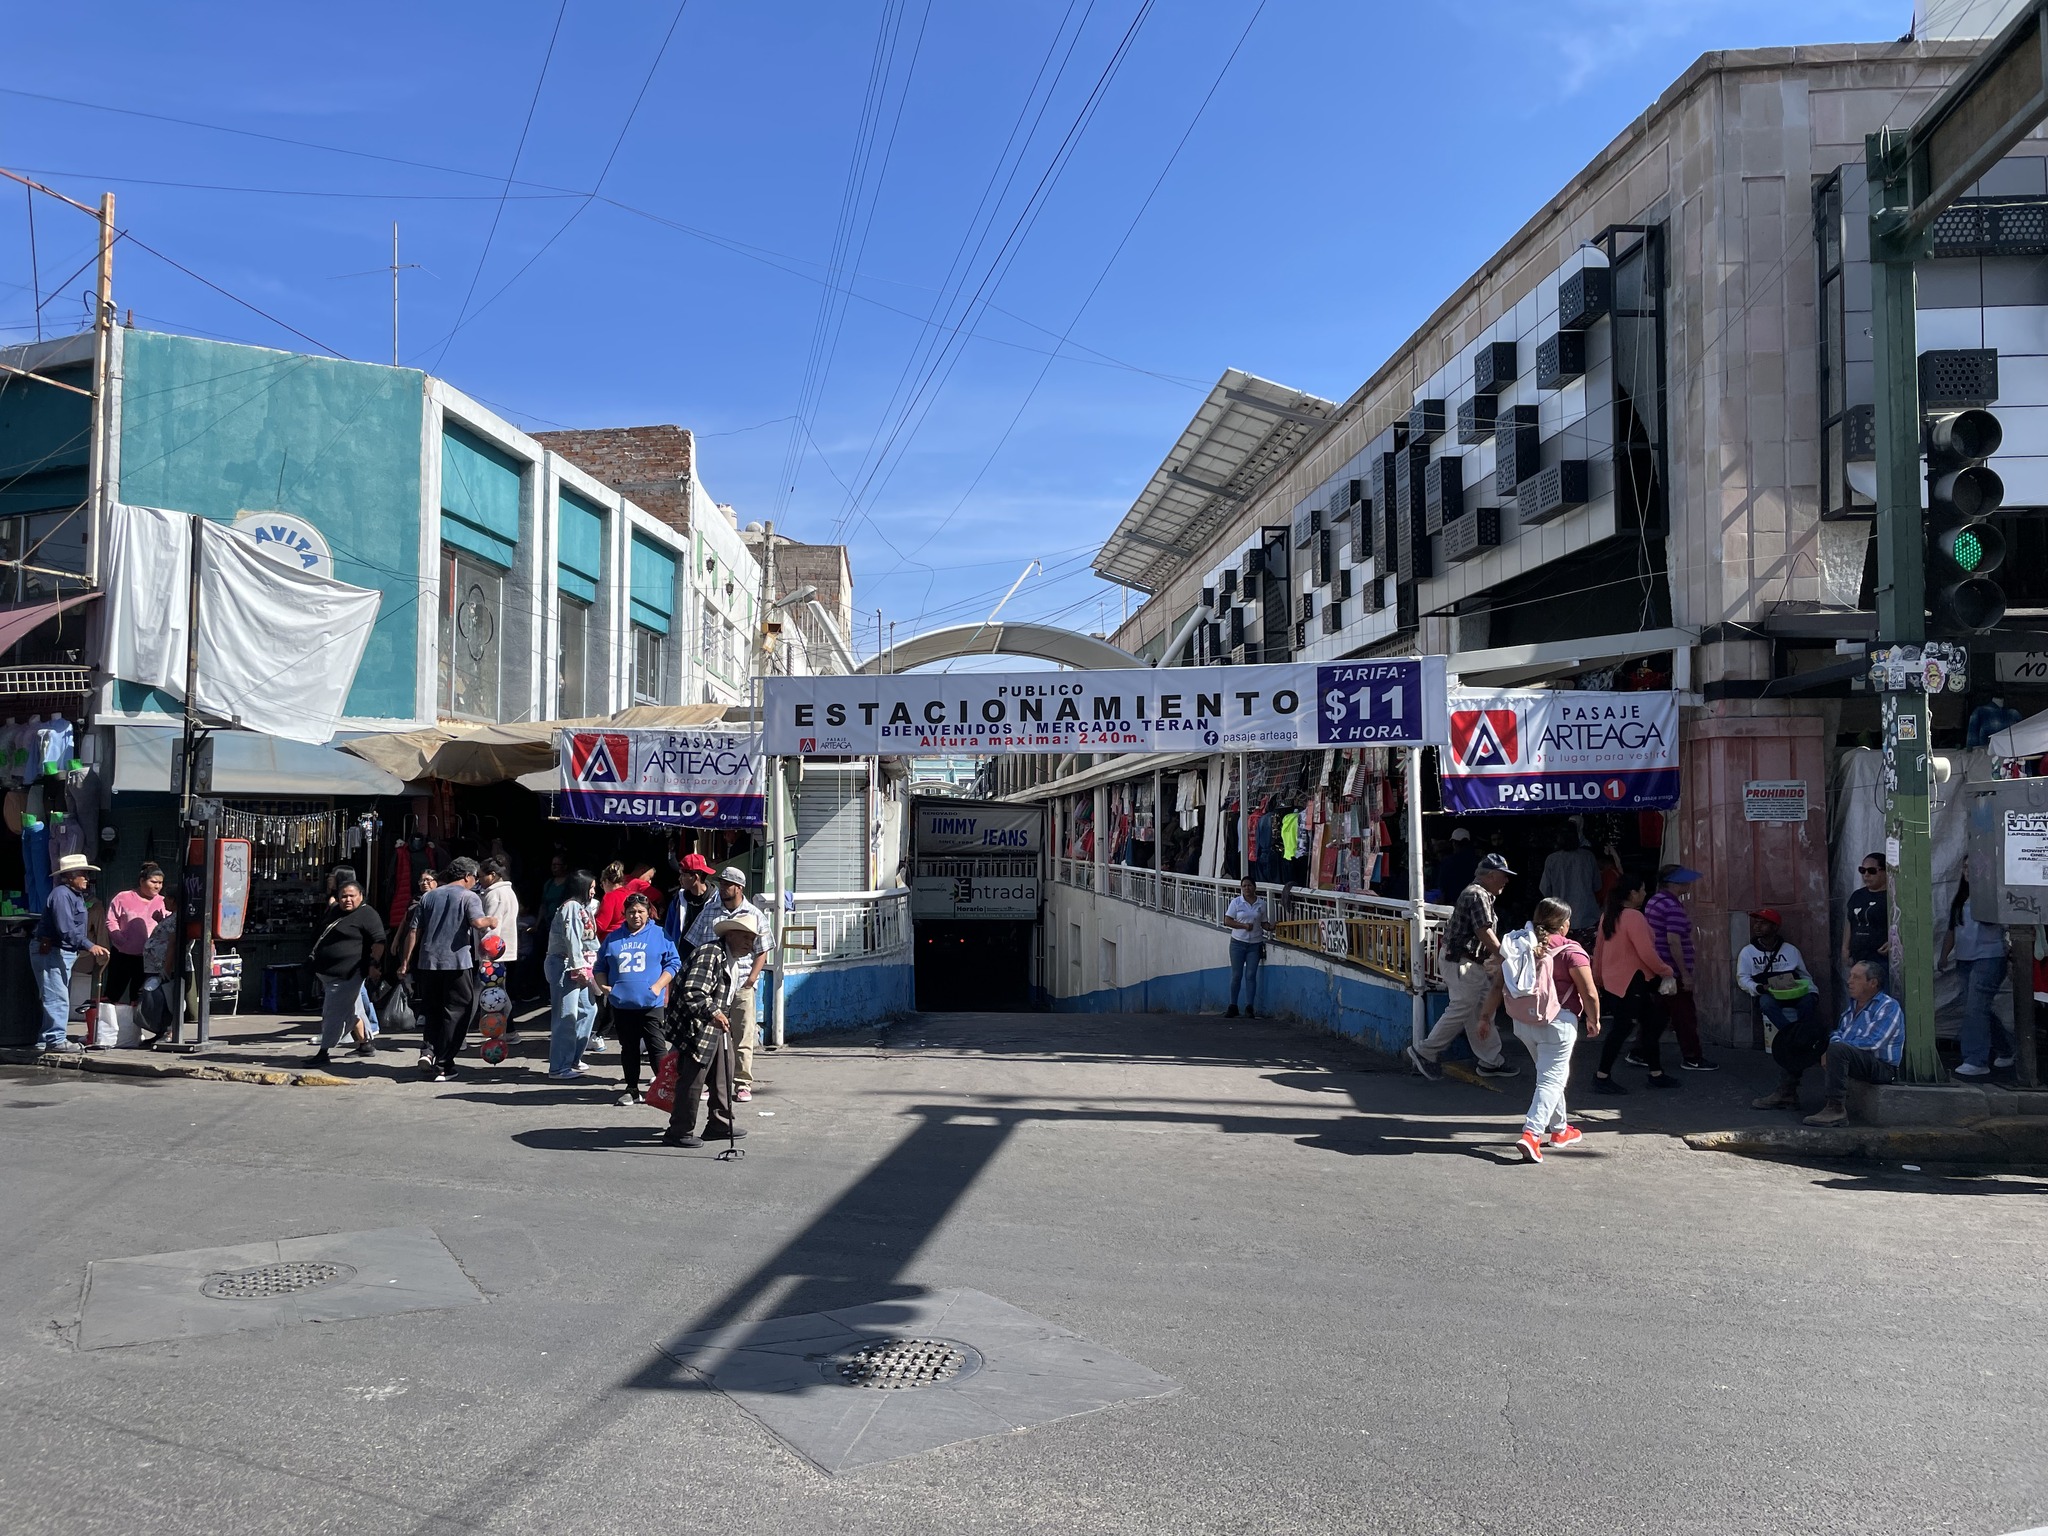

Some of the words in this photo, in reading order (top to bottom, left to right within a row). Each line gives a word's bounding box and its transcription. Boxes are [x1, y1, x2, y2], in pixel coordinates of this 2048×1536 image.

[1333, 666, 1406, 682] TARIFA:
[998, 684, 1084, 697] PUBLICO
[795, 690, 1299, 726] ESTACIONAMIENTO
[1325, 685, 1404, 724] $11
[1562, 705, 1640, 720] PASAJE
[882, 723, 1013, 737] BIENVENIDOS
[1036, 720, 1131, 735] MERCADO
[1329, 727, 1341, 740] X
[1348, 725, 1409, 740] HORA.
[669, 736, 735, 750] PASAJE
[920, 735, 979, 747] Altura
[988, 733, 1069, 746] maxima:
[1079, 732, 1145, 744] 2.40m.
[1223, 730, 1256, 744] pasaje
[1259, 730, 1298, 742] arteaga
[1538, 722, 1665, 751] ARTEAGA
[820, 742, 852, 750] ARTEAGA
[644, 751, 754, 775] ARTEAGA
[1543, 754, 1554, 763] Tu
[1559, 753, 1590, 764] lugar
[1595, 753, 1623, 763] para
[1629, 751, 1660, 760] vestir
[649, 776, 659, 784] Tu
[663, 775, 690, 786] lugar
[694, 777, 718, 786] para
[722, 776, 749, 785] vestir
[1498, 781, 1601, 802] PASILLO
[1607, 780, 1620, 798] 1
[1746, 789, 1805, 798] PROHIBIDO
[603, 798, 697, 816] PASILLO
[702, 800, 716, 816] 2
[931, 818, 977, 835] JIMMY
[982, 829, 1028, 847] JEANS
[1327, 920, 1344, 936] CUPO
[620, 941, 648, 951] JORDAN
[618, 951, 646, 973] 23
